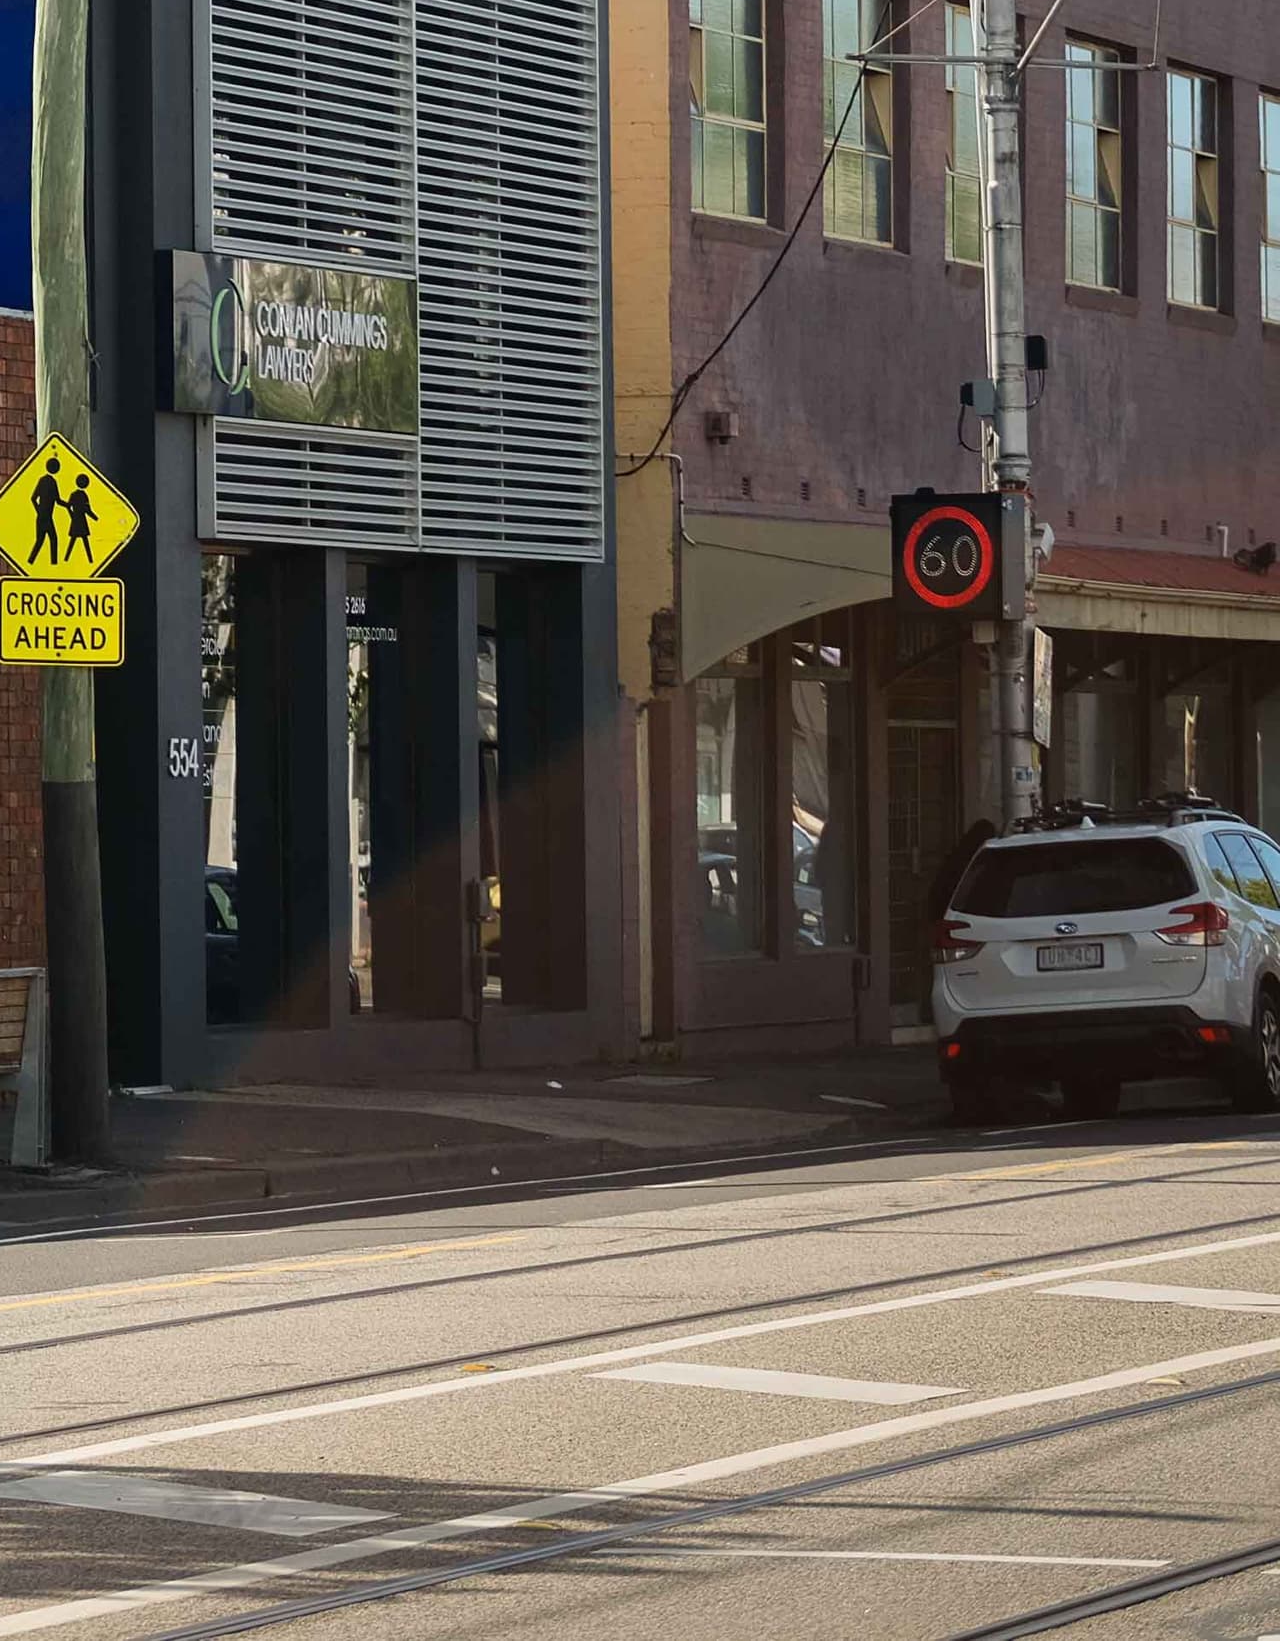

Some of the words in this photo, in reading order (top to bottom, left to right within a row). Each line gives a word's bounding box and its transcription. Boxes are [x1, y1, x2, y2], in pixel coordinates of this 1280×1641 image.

[317, 307, 387, 351] CUMMINGS
[256, 344, 314, 383] LAWYERS
[920, 535, 979, 577] 60
[6, 592, 114, 618] CROSSING
[14, 626, 107, 651] AHEAD
[168, 737, 199, 779] 554
